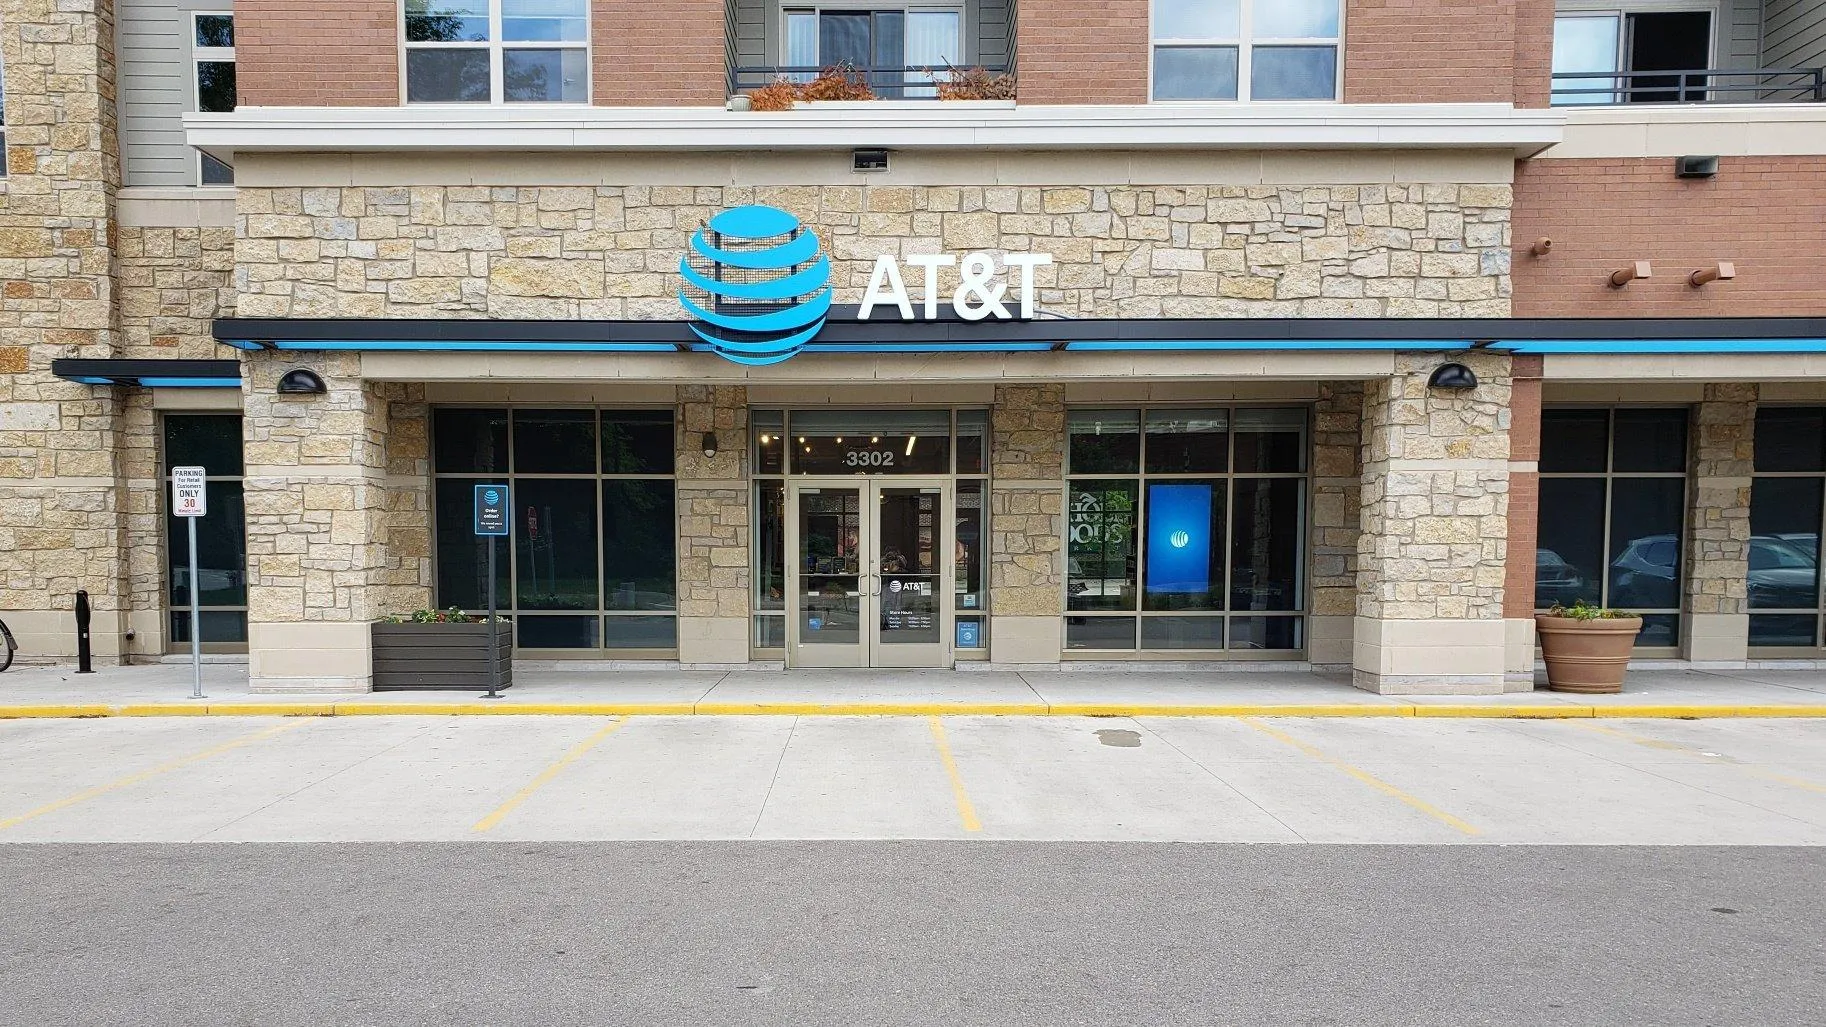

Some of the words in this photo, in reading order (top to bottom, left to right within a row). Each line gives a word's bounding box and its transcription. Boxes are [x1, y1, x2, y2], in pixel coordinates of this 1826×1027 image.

[857, 252, 1053, 321] AT&T
[846, 451, 894, 467] 3302
[179, 490, 200, 498] ONLY
[184, 499, 196, 508] 30
[902, 582, 926, 591] AT&T
